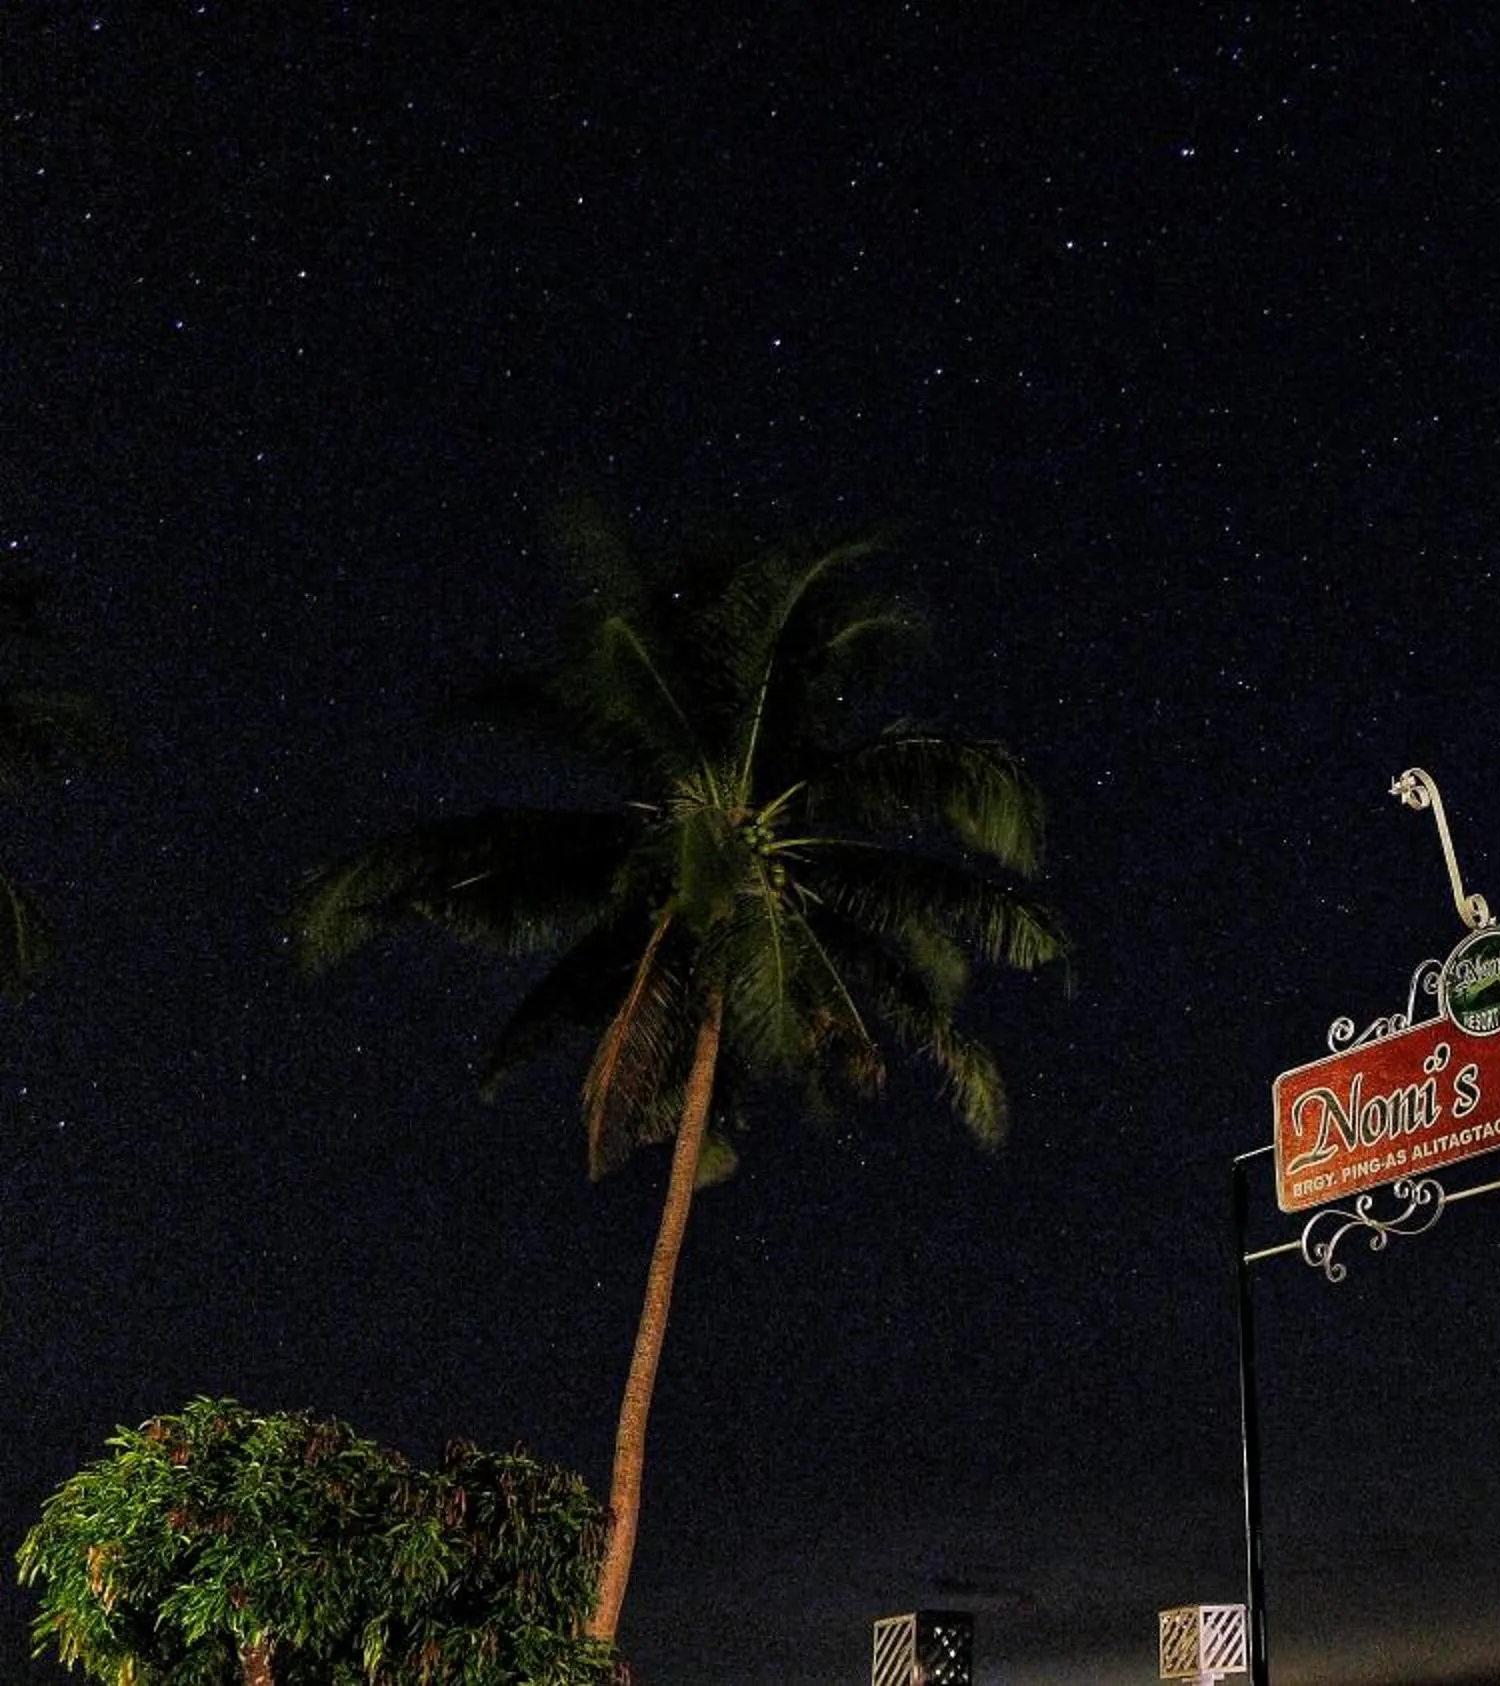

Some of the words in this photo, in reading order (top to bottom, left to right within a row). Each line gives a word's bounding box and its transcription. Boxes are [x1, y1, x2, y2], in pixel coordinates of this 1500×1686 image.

[1287, 1042, 1480, 1175] Noni's
[1293, 1173, 1337, 1197] BRGY.
[1343, 1148, 1407, 1183] PING-AS
